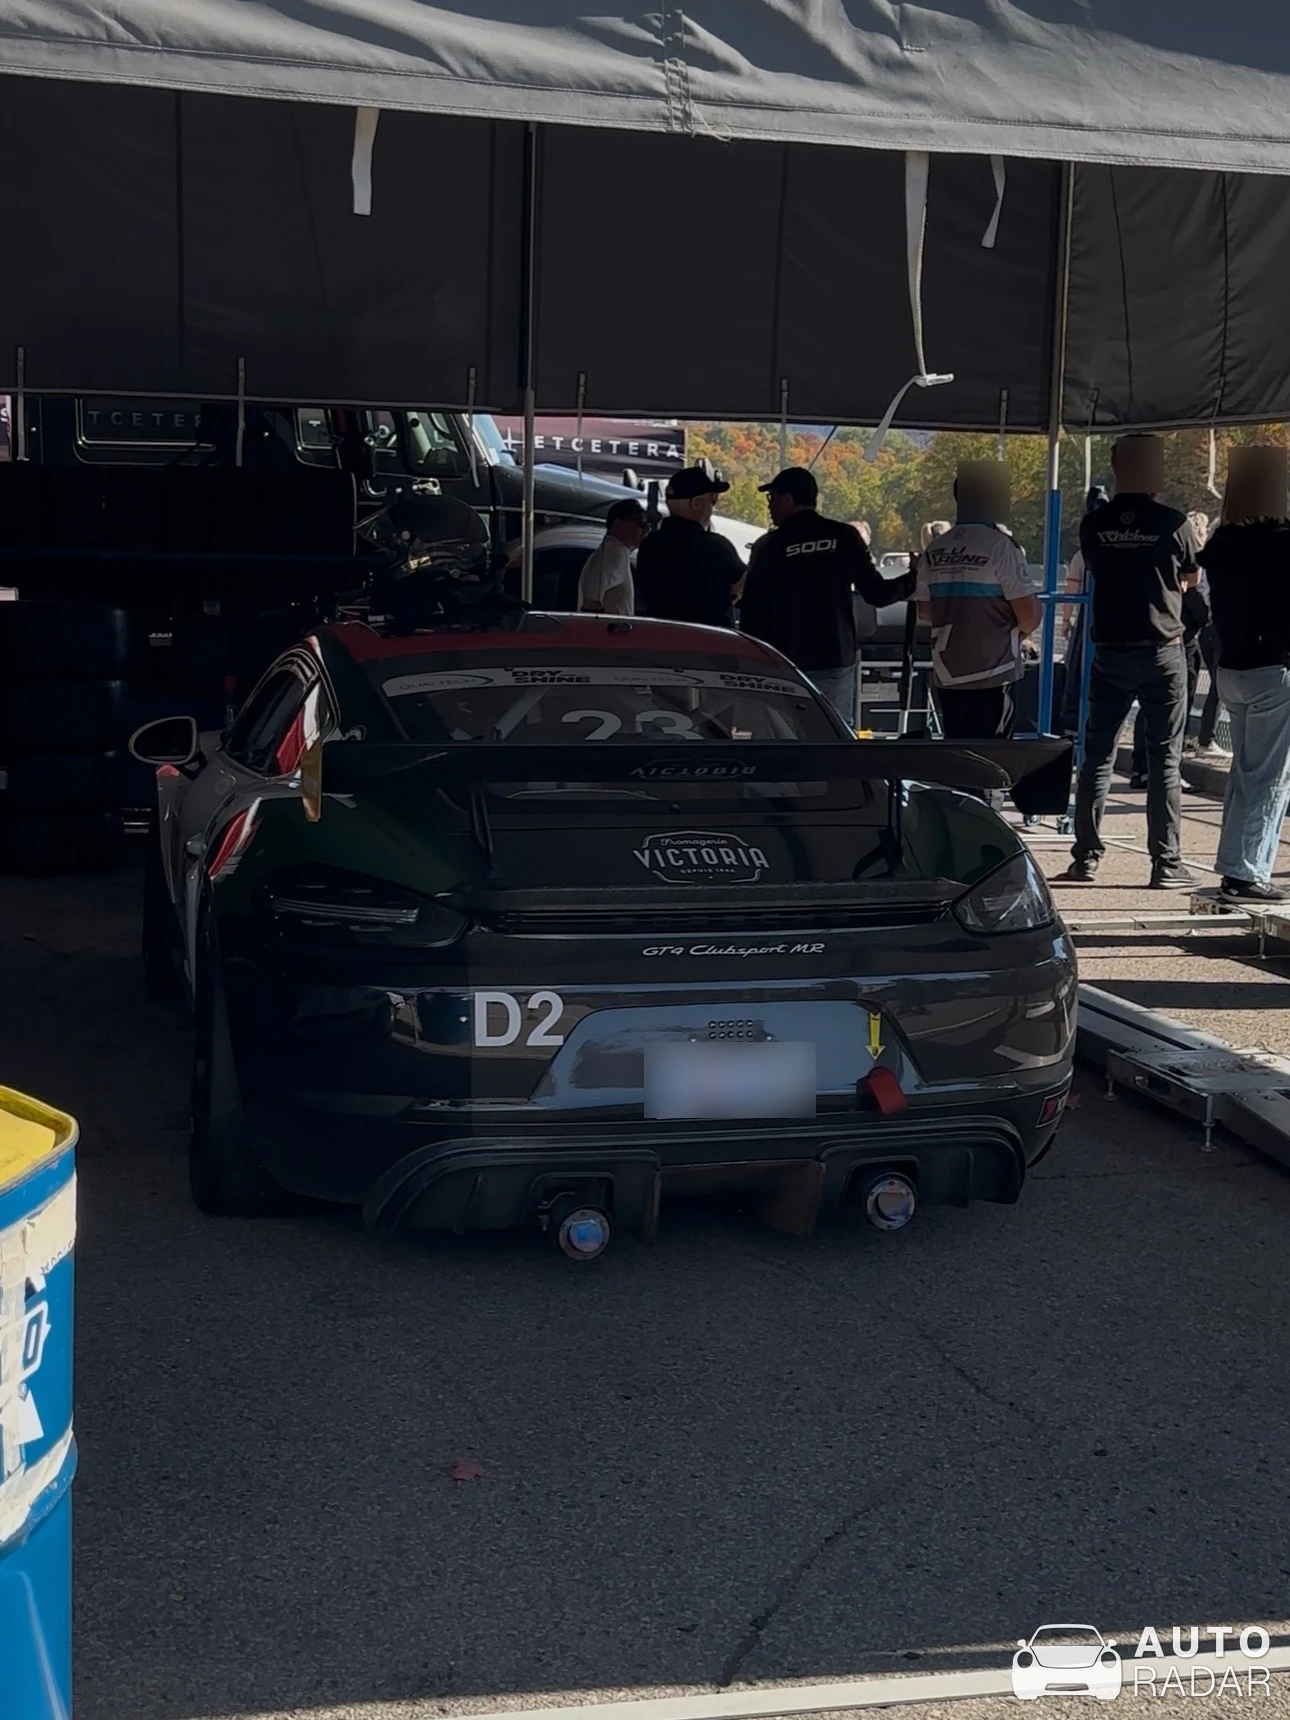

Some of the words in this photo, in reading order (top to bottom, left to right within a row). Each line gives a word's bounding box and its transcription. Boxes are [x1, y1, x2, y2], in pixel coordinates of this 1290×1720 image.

[534, 435, 681, 458] ETCETERA
[785, 538, 838, 558] SODI
[719, 674, 767, 682] DRY
[724, 681, 796, 694] SHINE
[660, 838, 729, 847] Fromagerie
[632, 847, 770, 870] VICTORIA
[642, 946, 684, 957] GT4
[688, 942, 787, 958] Clubsport
[789, 942, 826, 954] MR
[474, 990, 565, 1047] D2
